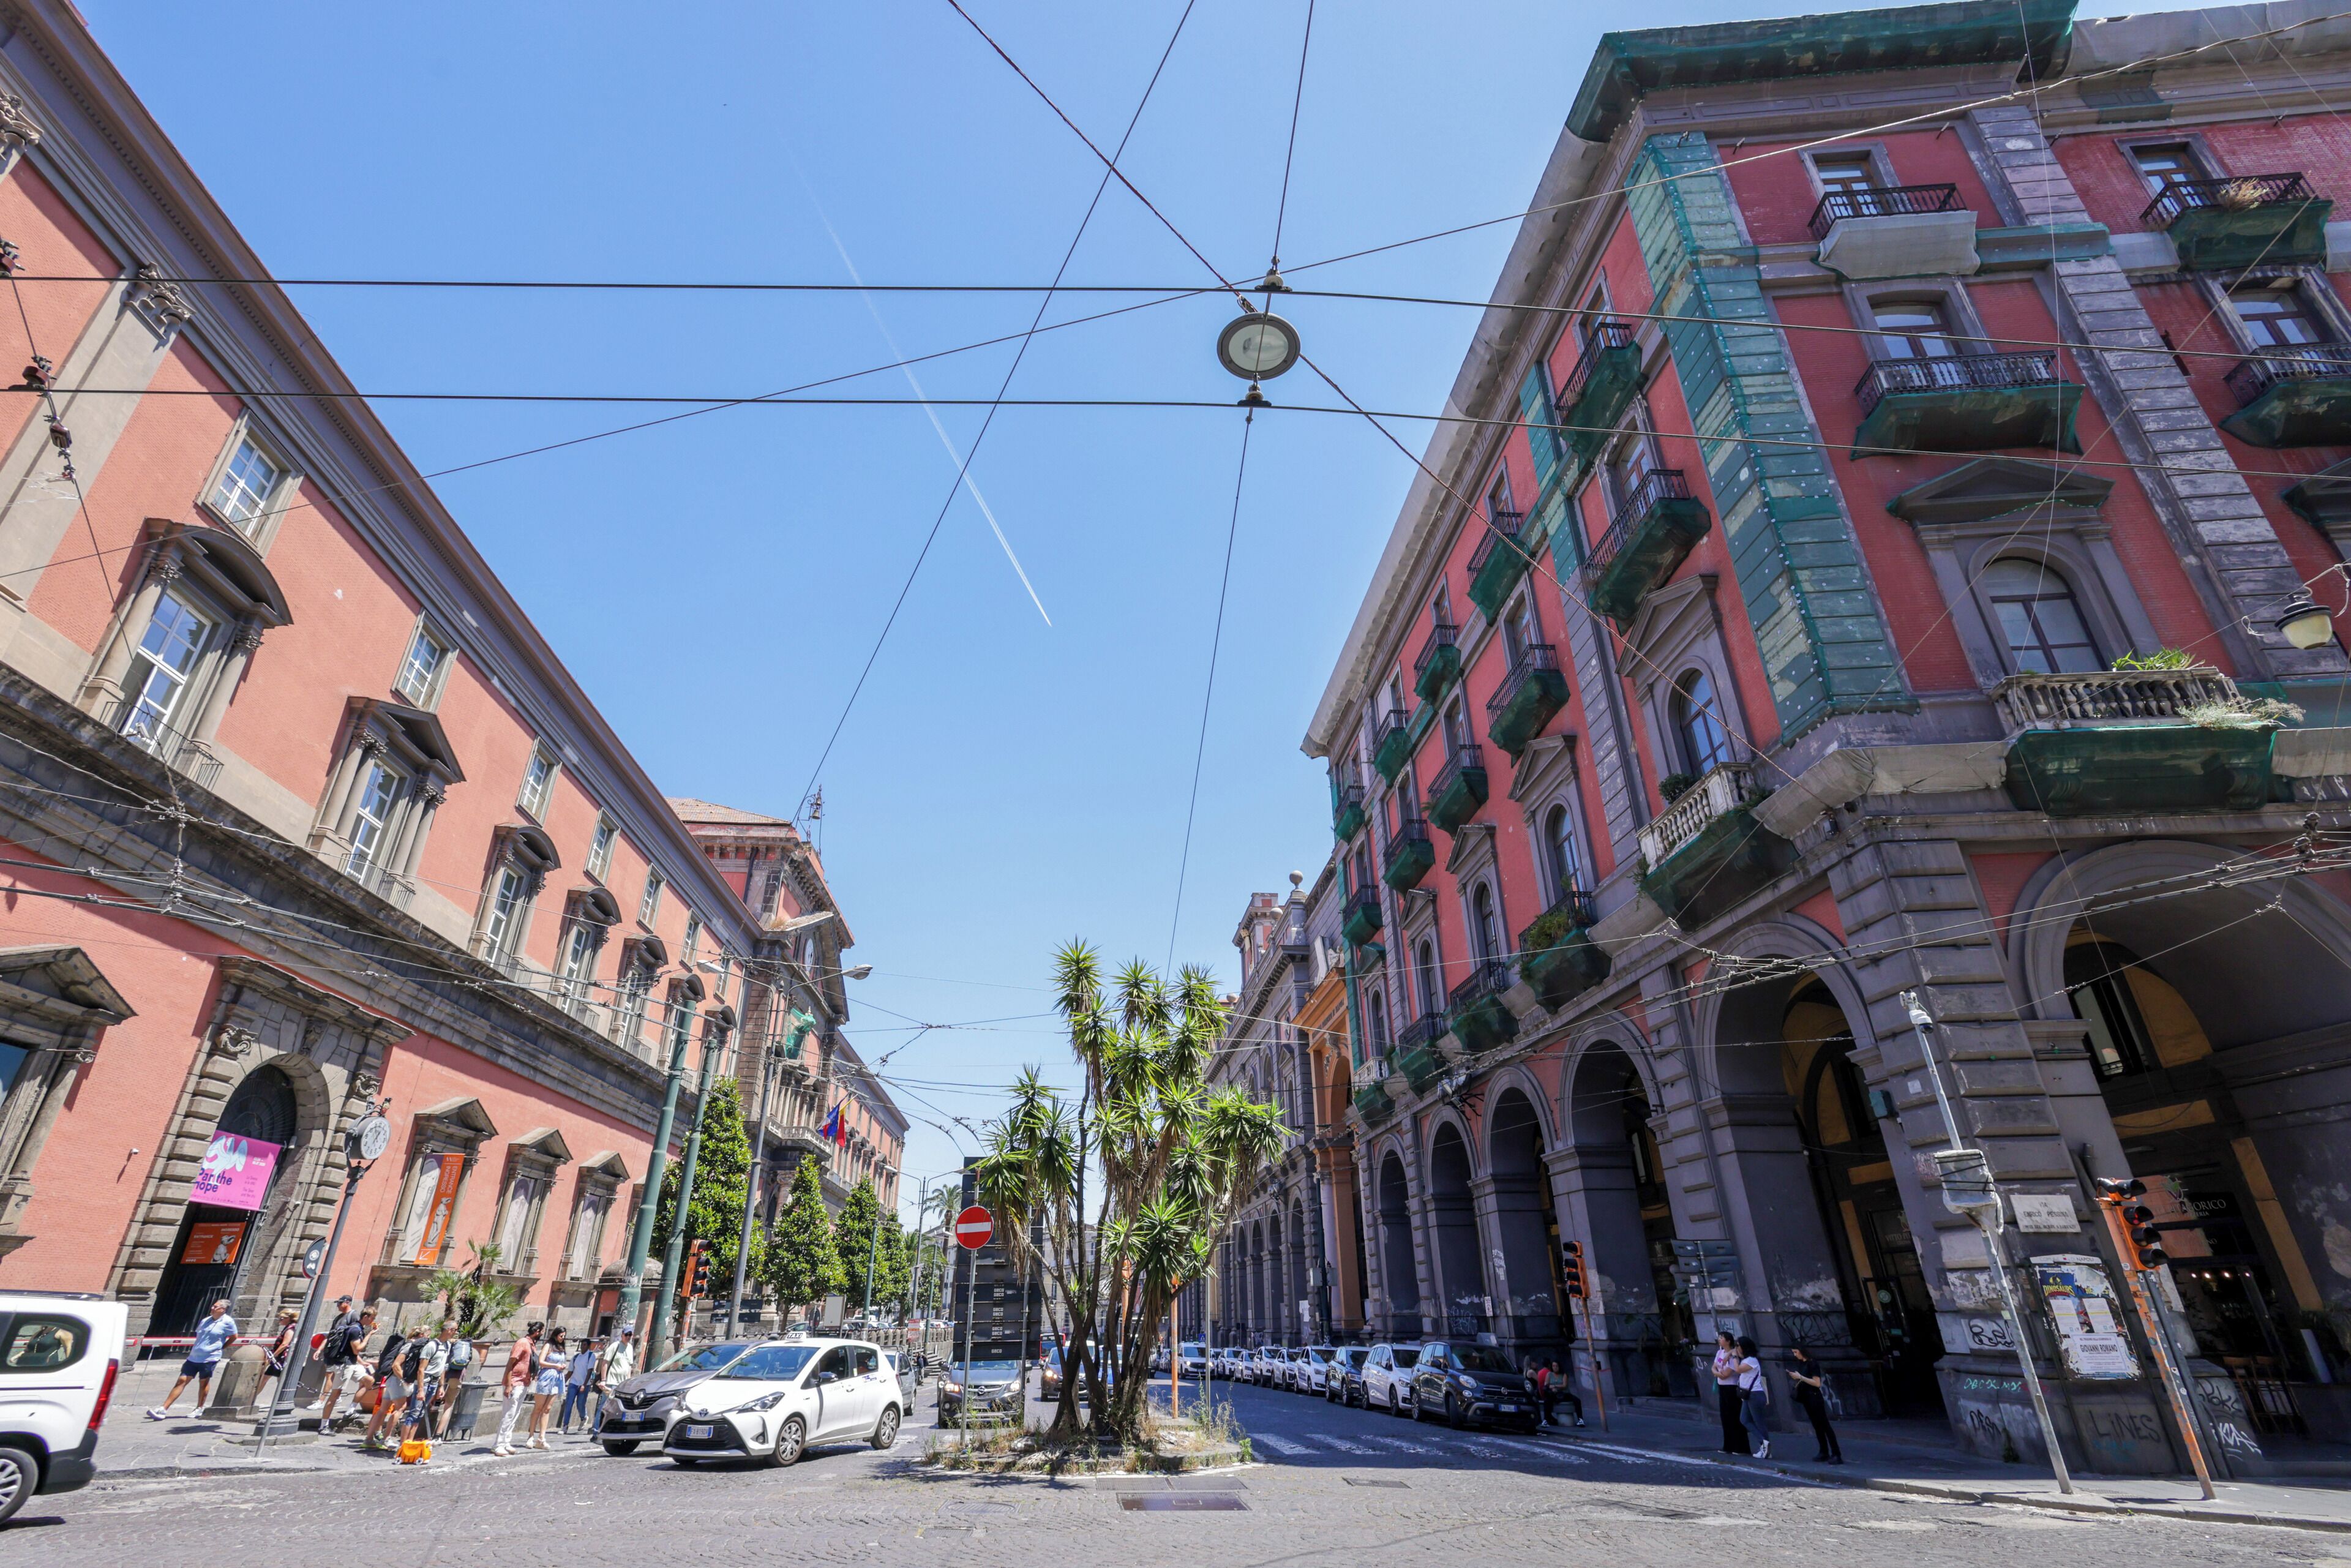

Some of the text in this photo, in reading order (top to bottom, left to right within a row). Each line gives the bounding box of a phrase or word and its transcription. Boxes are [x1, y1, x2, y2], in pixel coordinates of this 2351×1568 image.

[440, 1165, 451, 1193] INGRESSO
[446, 1166, 458, 1195] ENTRANCE
[2042, 1285, 2075, 1297] DINOSAURS
[2080, 1344, 2118, 1352] GIOVANNI ROMANO
